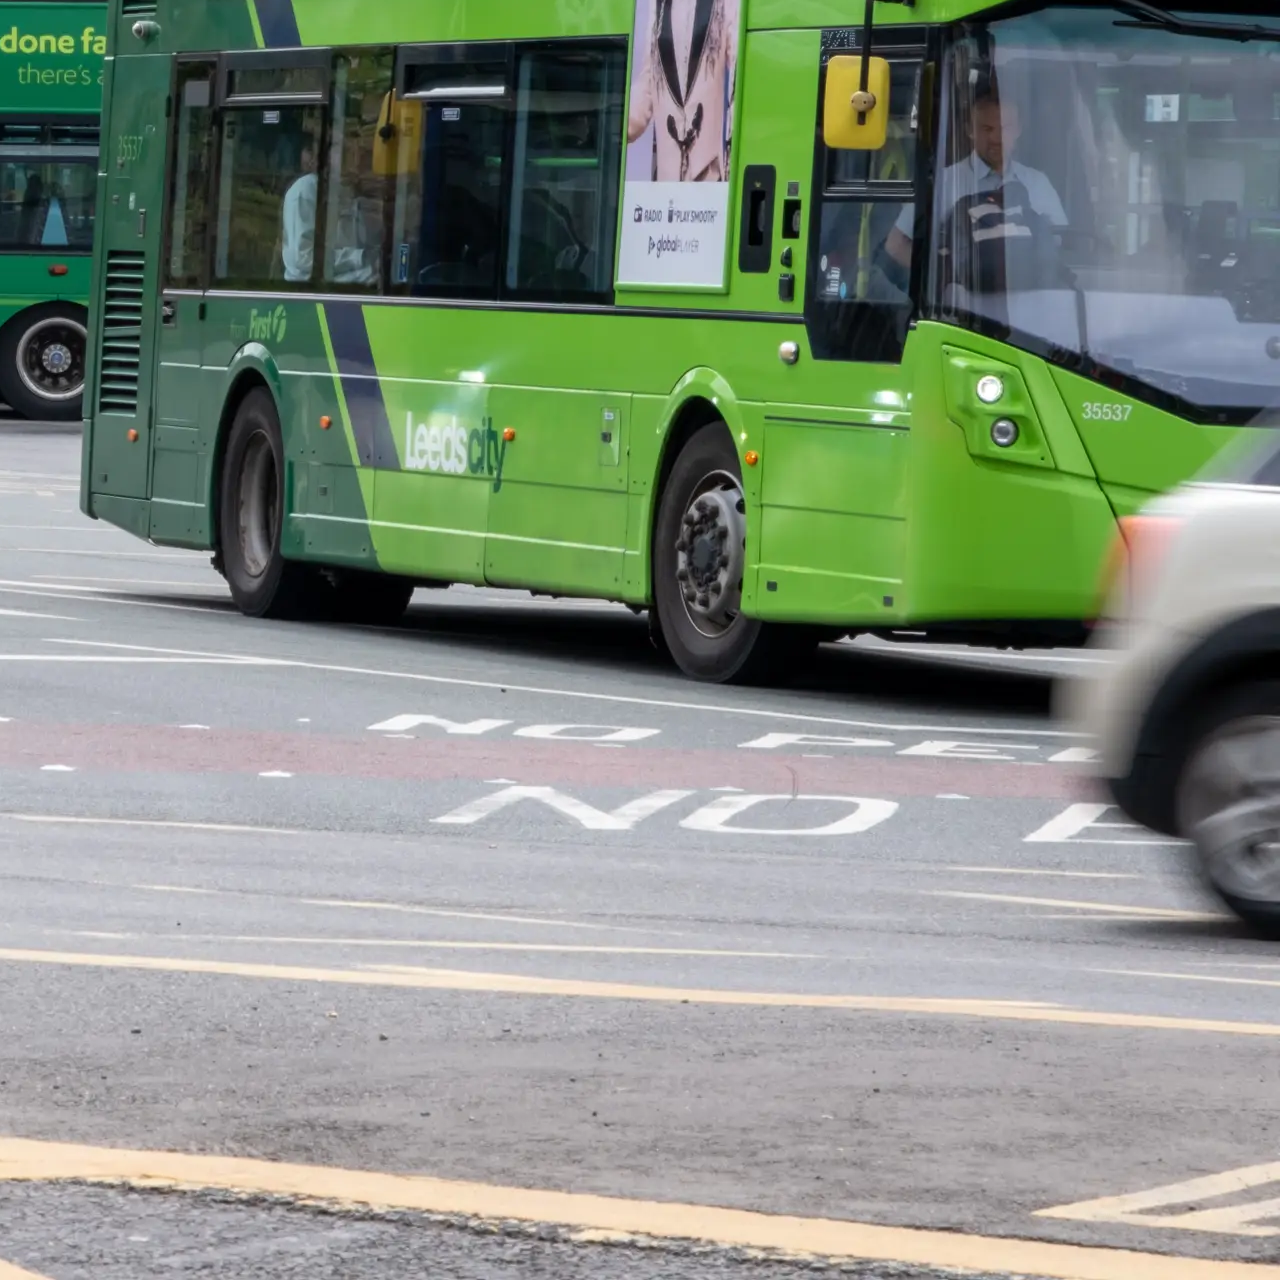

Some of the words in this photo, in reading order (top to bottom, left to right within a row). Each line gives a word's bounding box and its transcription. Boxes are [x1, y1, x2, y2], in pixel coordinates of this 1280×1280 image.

[0, 26, 75, 54] done
[644, 209, 663, 222] RADIO
[1082, 401, 1132, 421] 35537
[367, 713, 662, 741] NO
[428, 786, 900, 836] NO
